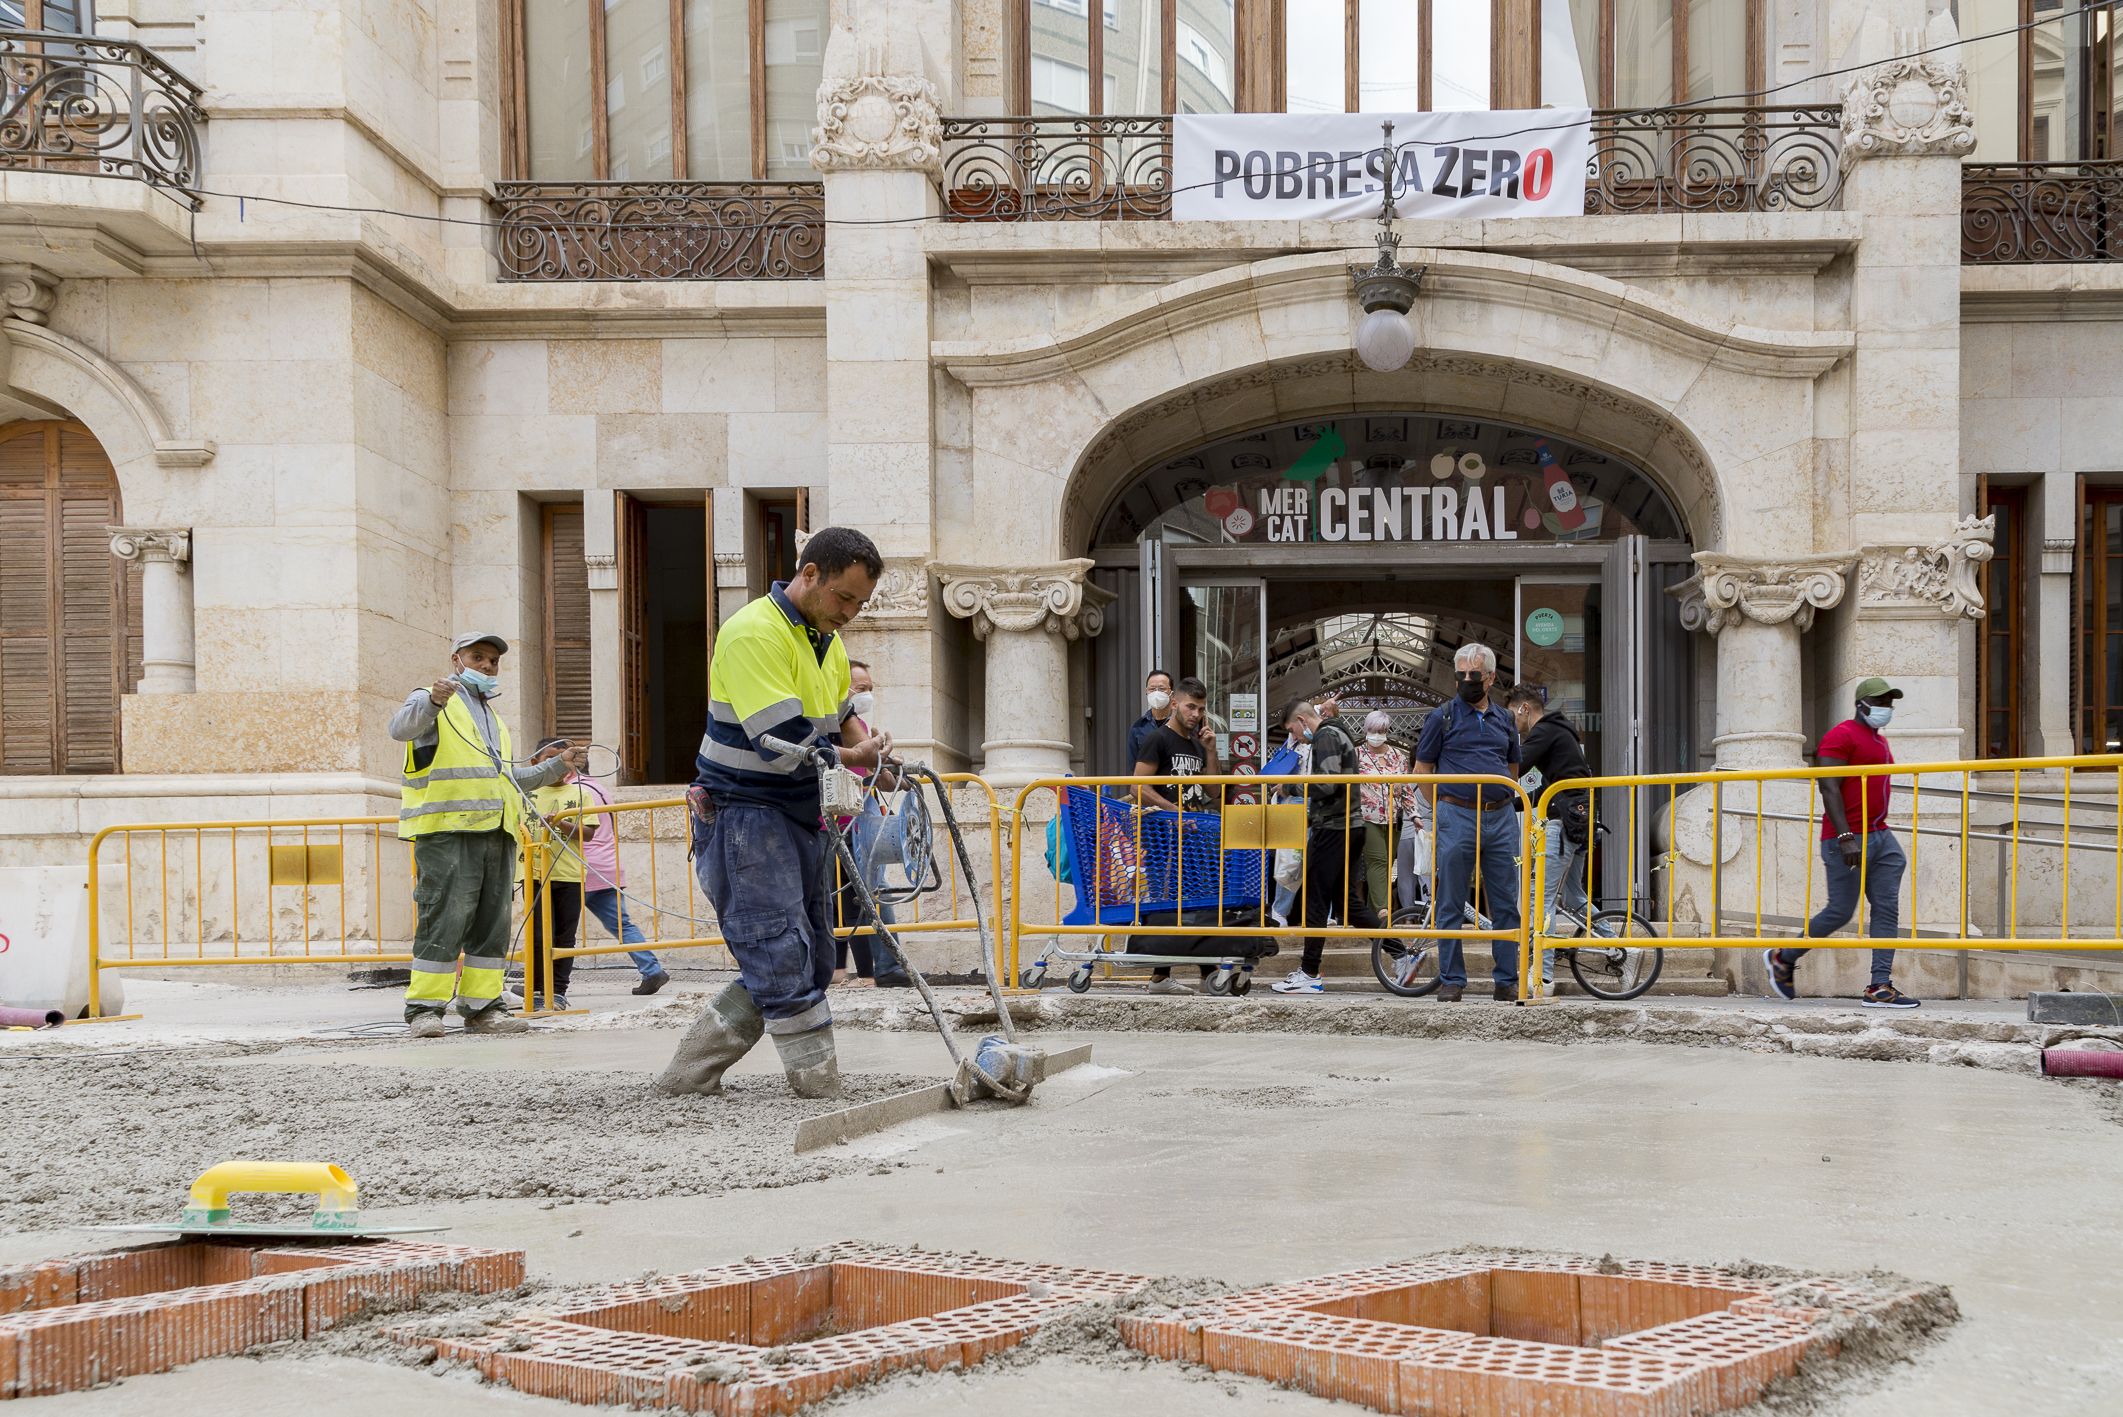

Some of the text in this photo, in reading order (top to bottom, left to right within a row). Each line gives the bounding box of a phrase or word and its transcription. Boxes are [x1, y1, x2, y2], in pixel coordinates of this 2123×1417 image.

[1215, 146, 1554, 201] POBRESA ZERO
[1261, 488, 1308, 515] MER
[1553, 490, 1573, 502] TURIA
[1320, 486, 1518, 542] CENTRAL
[1267, 515, 1308, 542] CAT
